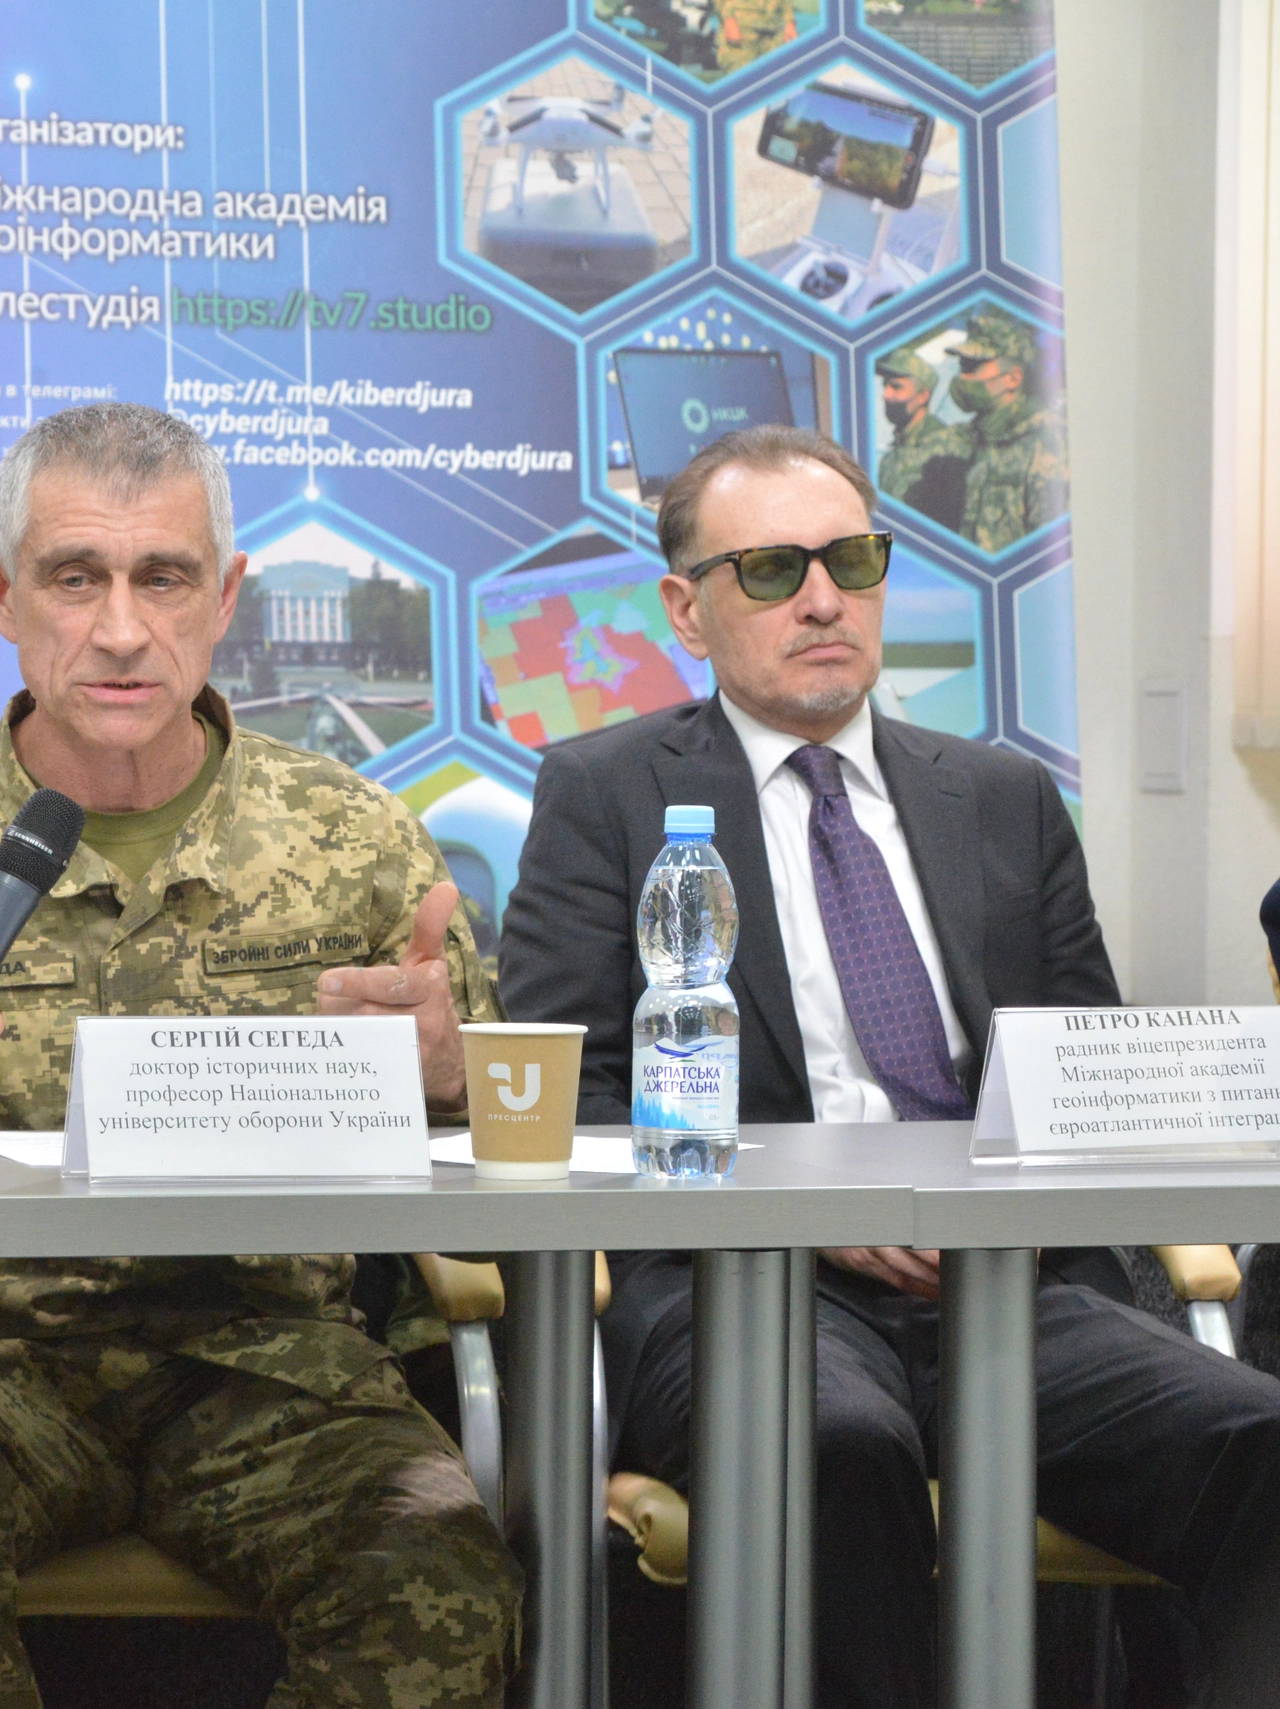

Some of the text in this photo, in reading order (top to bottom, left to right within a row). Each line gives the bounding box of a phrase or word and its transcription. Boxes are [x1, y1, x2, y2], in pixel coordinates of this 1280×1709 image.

[213, 187, 386, 226] академія
[170, 287, 491, 332] https://tv7.studio
[6, 384, 16, 396] в
[165, 377, 473, 412] https://t.me/kiberdjura
[213, 933, 362, 964] ЗБРОЙНІ СИЛИ УКРАЇНИ
[1064, 1009, 1241, 1031] ПЕТРО КАНАНА
[150, 1026, 345, 1051] СЕРГІЙ СЕГЕДА
[1055, 1037, 1267, 1062] радник віцепрезидента
[129, 1056, 378, 1080] доктор історичних наук,
[643, 1065, 720, 1079] КАРПАТСЬКА
[1060, 1057, 1265, 1085] Міжнародної академії
[126, 1083, 381, 1107] професор Національного
[643, 1080, 720, 1093] ДЖЕРЕЛЬНА
[1052, 1089, 1202, 1111] геоінформатики
[1206, 1090, 1217, 1102] з
[98, 1110, 411, 1135] університету оборони України
[487, 1113, 541, 1122] ПРЕСЦЕНТР
[1049, 1112, 1203, 1139] євроатлантичної
